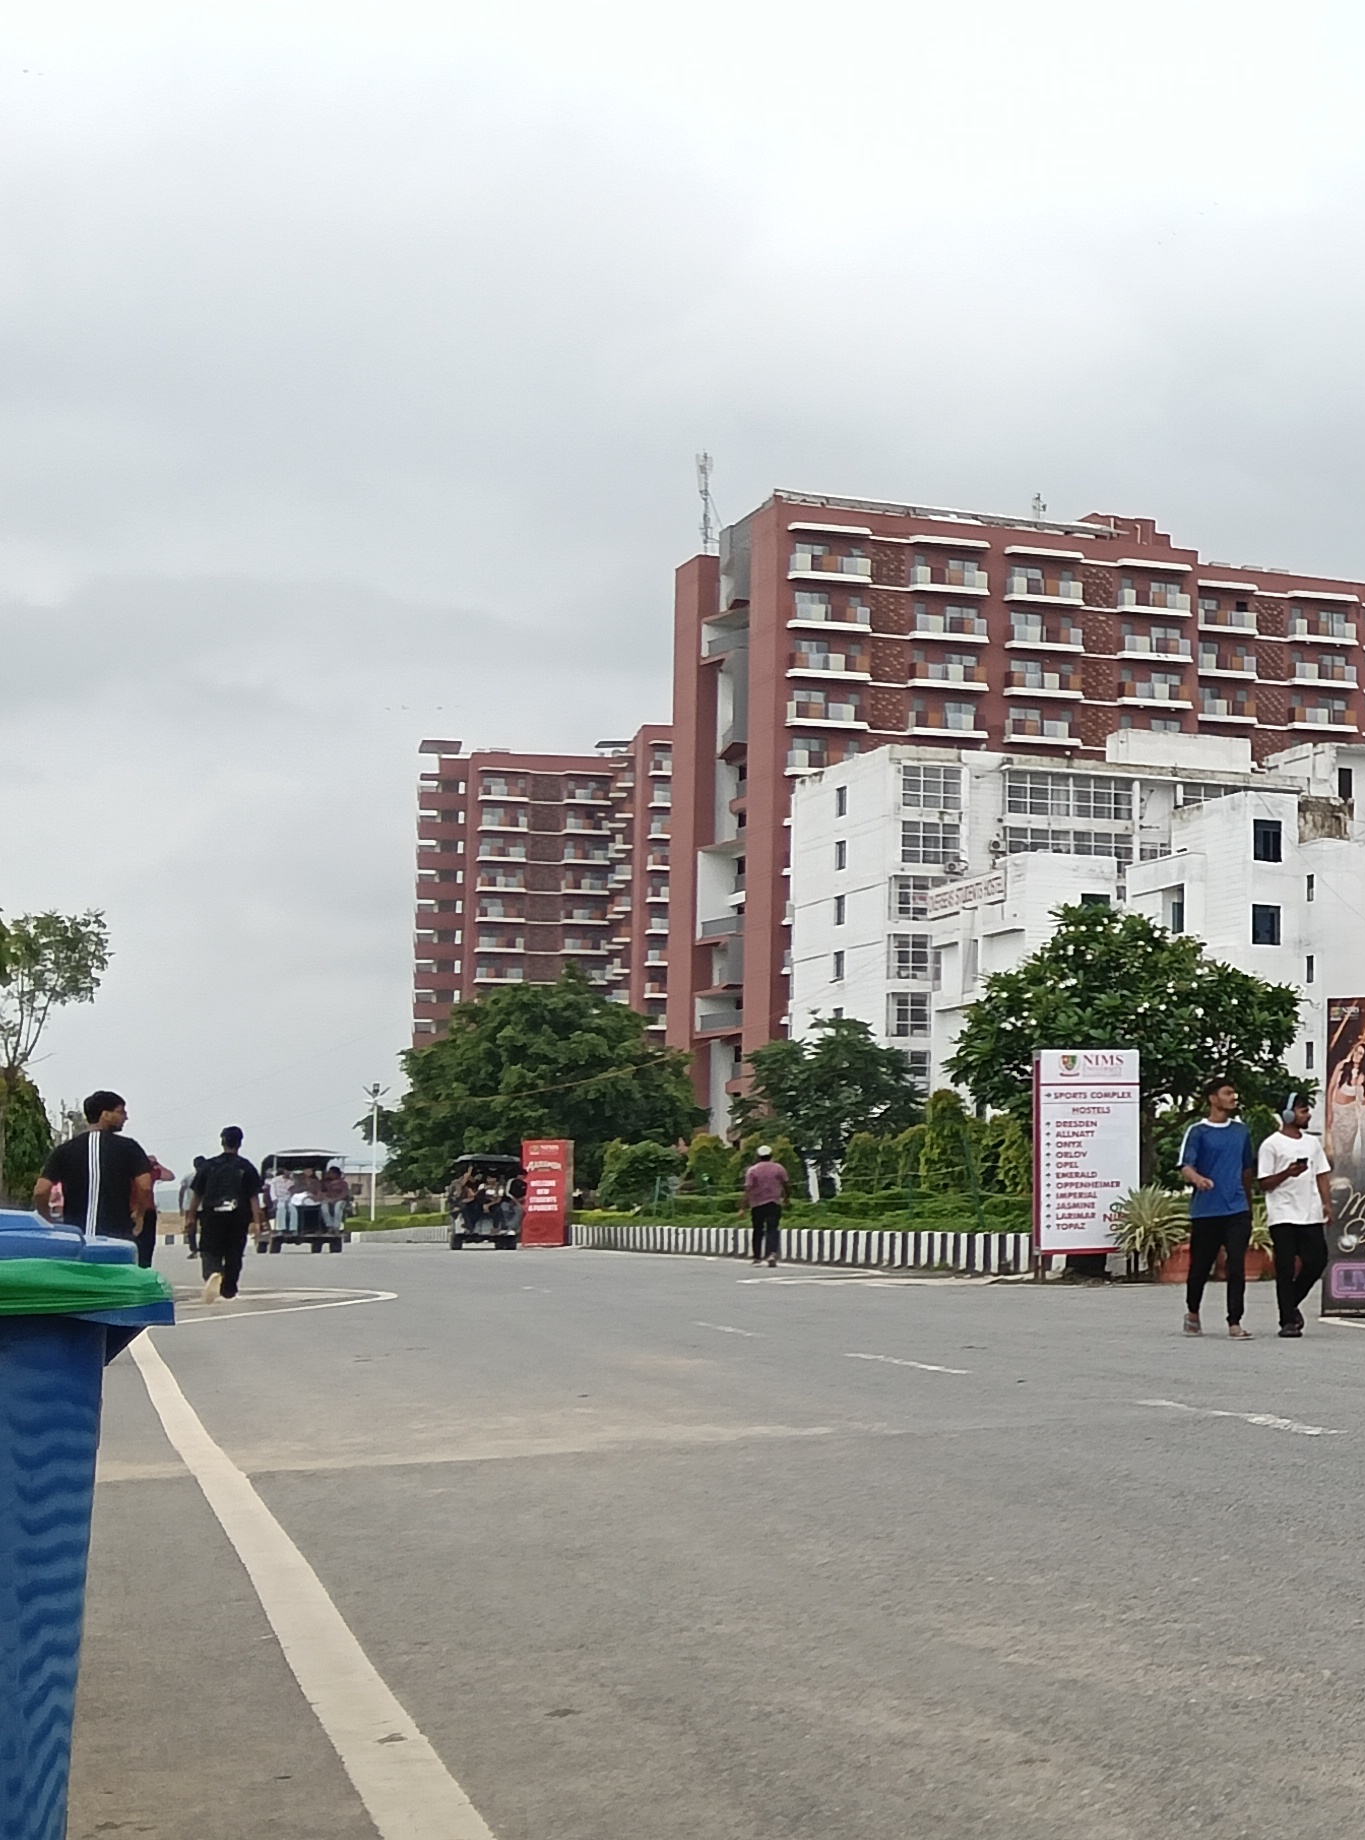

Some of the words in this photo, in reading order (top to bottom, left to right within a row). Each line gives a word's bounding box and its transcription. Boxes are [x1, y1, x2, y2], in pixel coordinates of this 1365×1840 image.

[1083, 1054, 1124, 1066] NIMS
[1053, 1091, 1088, 1100] SPORTS
[1090, 1091, 1132, 1099] COMPLEX
[1072, 1106, 1111, 1114] HOSTELS
[1055, 1120, 1097, 1128] DRESDEN
[1055, 1130, 1095, 1138] ALLNATT
[1055, 1161, 1079, 1169] OPEL
[1055, 1171, 1098, 1179] EMERALD
[1055, 1180, 1121, 1189] OPPENHEIMER
[1055, 1191, 1098, 1199] IMPERIAL
[1055, 1202, 1096, 1210] JASMINE
[1055, 1212, 1097, 1220] LARIMAR
[1055, 1222, 1087, 1231] TOPAZ
